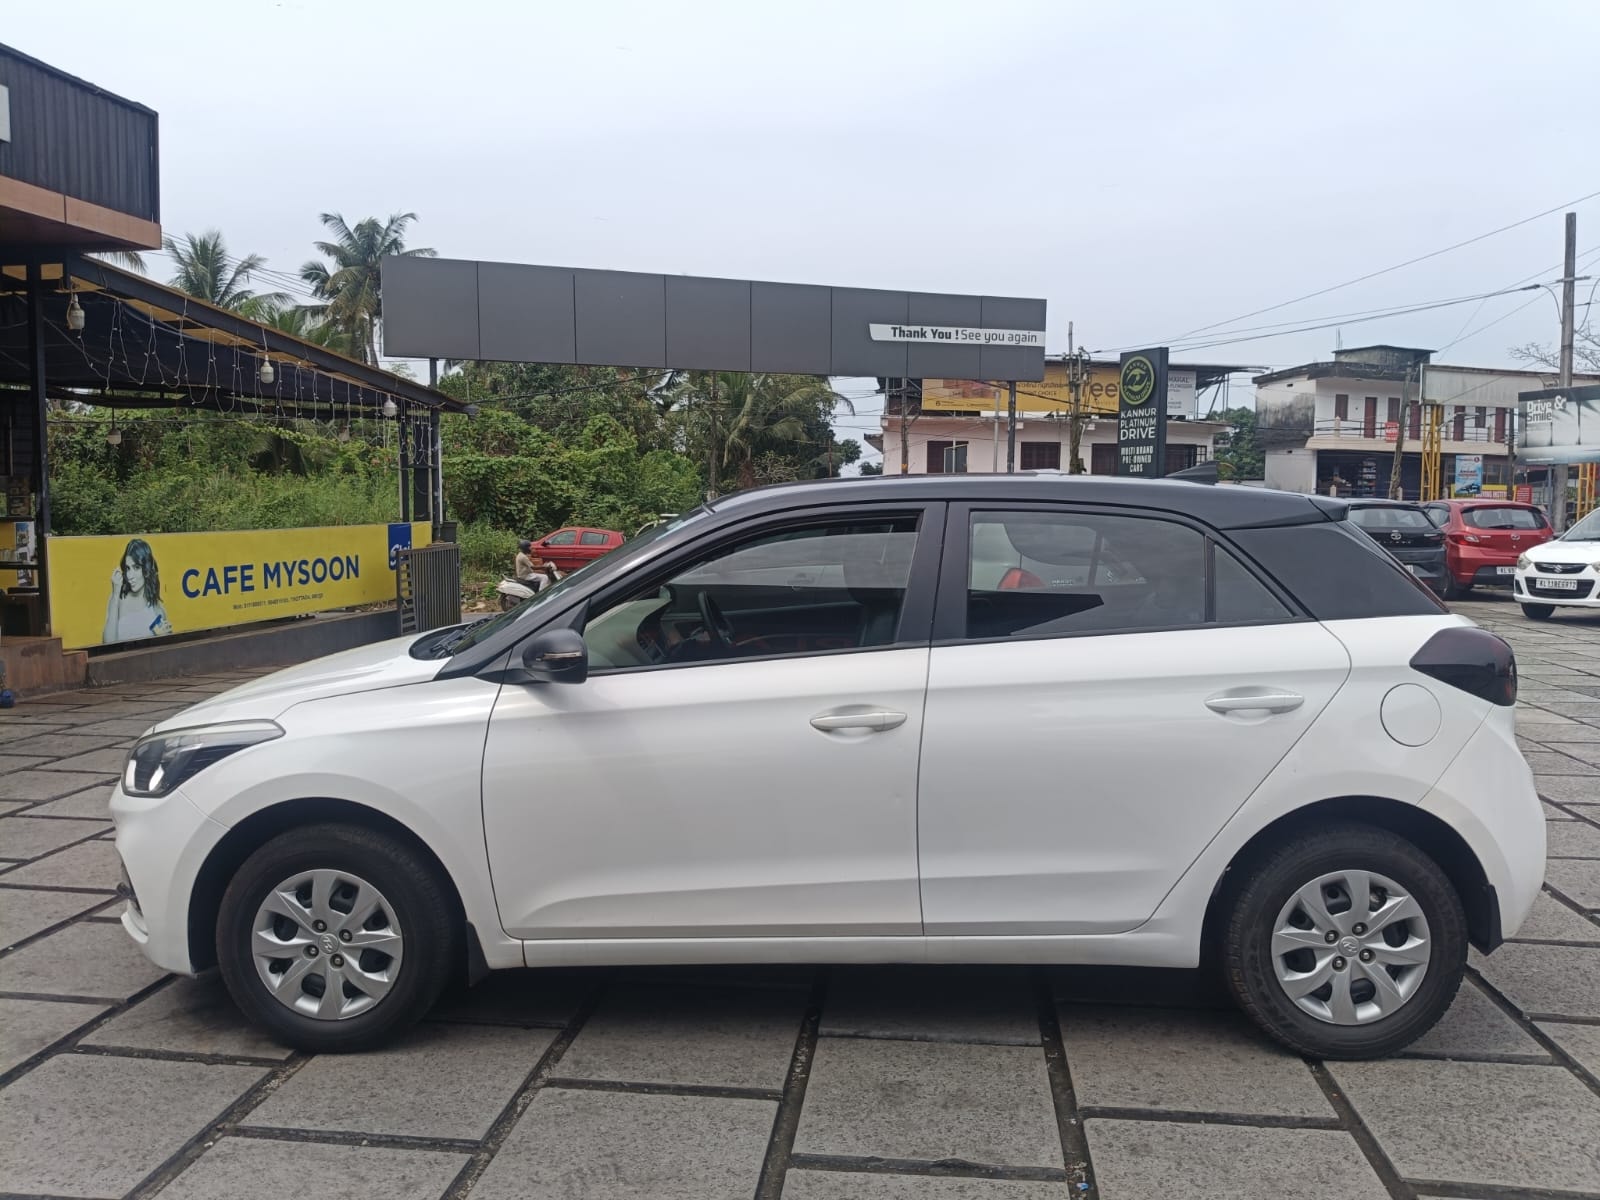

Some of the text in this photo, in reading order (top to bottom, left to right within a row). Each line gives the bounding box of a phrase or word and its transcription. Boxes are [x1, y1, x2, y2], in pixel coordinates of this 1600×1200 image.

[891, 326, 927, 339] Thank
[931, 328, 952, 340] You
[961, 329, 981, 341] See
[984, 332, 1004, 343] you
[1007, 331, 1037, 345] again
[1527, 395, 1567, 412] Drive &
[1120, 408, 1157, 419] KANNUR
[1526, 410, 1552, 422] Smile
[1120, 417, 1157, 428] PLATINUM
[1120, 427, 1156, 440] DRIVE
[1129, 464, 1143, 472] CARS
[182, 554, 360, 598] CAFE MYSOON
